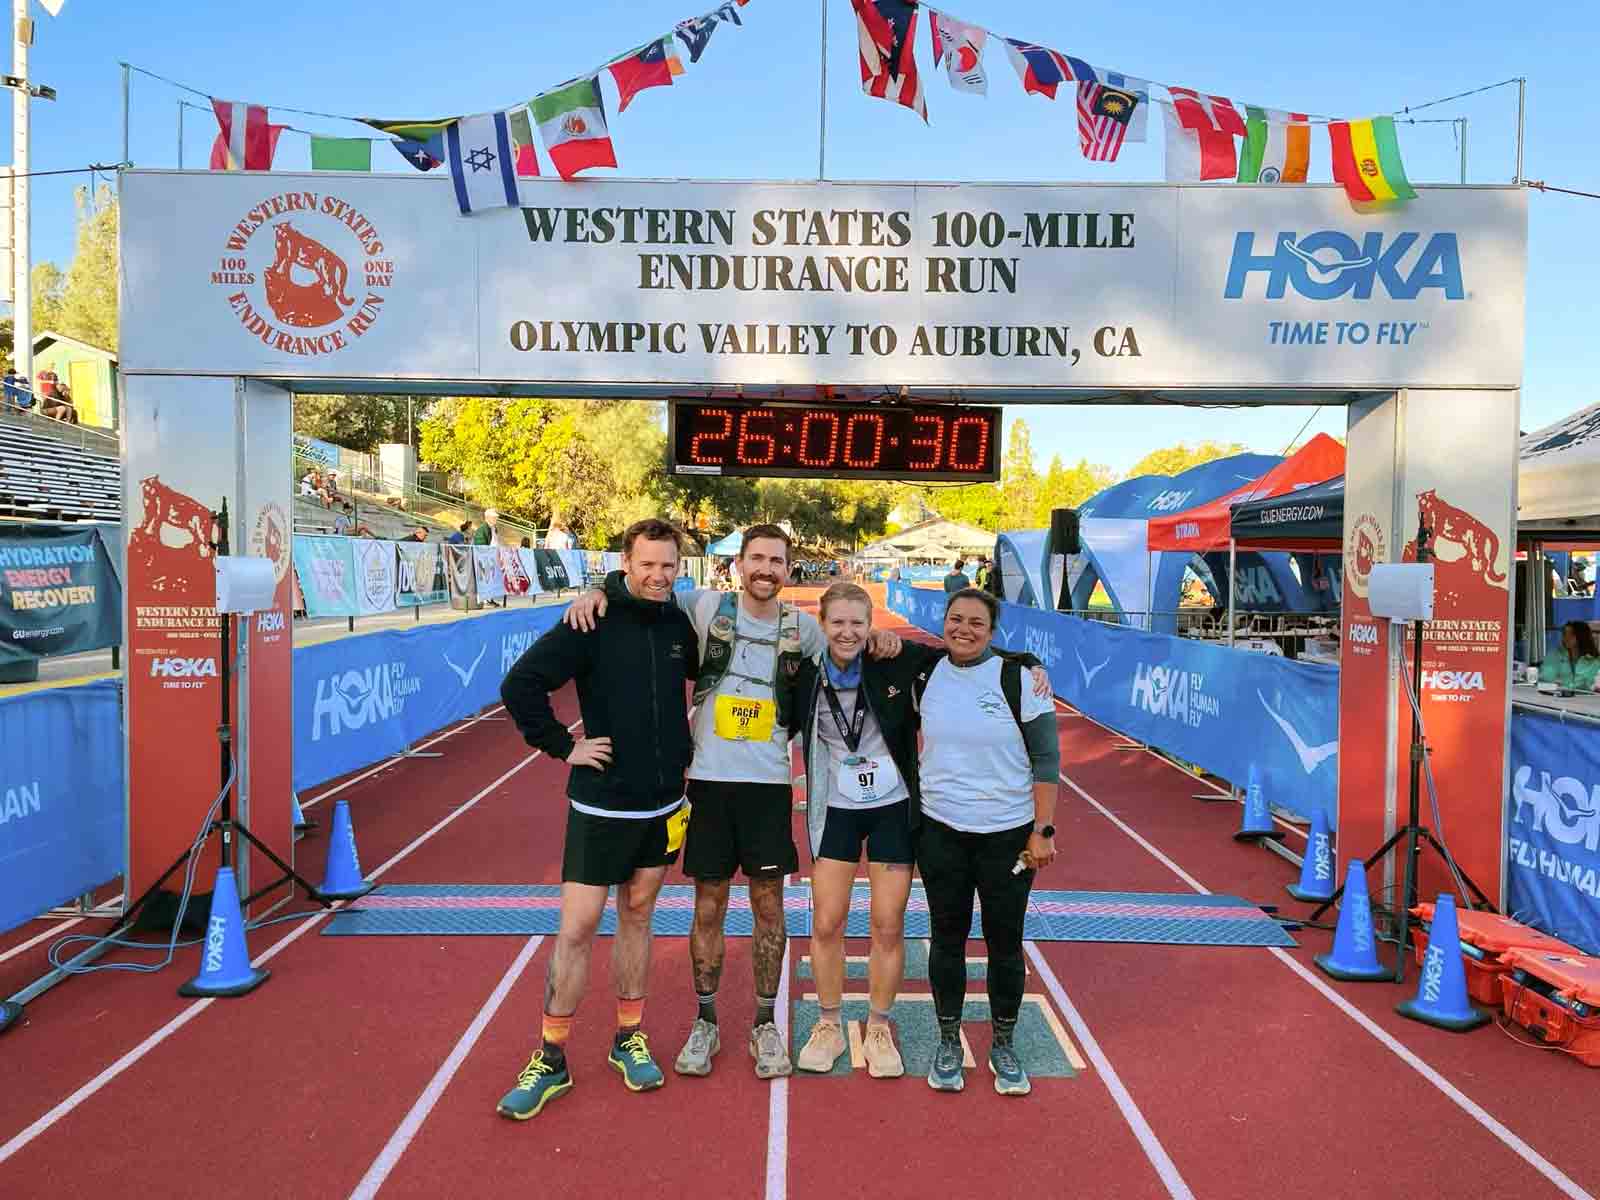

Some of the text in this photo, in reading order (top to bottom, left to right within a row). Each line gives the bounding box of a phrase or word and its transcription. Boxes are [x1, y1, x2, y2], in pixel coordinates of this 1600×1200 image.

[227, 192, 384, 255] WESTERN STATES
[520, 206, 1135, 248] WESTERN STATES 100-MILE
[220, 258, 246, 271] 100
[364, 261, 394, 273] ONE
[637, 254, 1020, 293] ENDURANCE RUN
[1224, 230, 1464, 300] HOKA
[211, 272, 255, 285] MILES
[365, 275, 393, 287] DAY
[228, 291, 384, 355] ENDURANCE RUN
[1269, 321, 1328, 345] TIME
[1335, 322, 1369, 345] TO
[510, 320, 1142, 366] OLYMPIC VALLEY TO AUBURN, CA
[1260, 504, 1324, 524] GUENERGY.COM
[0, 545, 95, 566] HYDRATION
[5, 567, 72, 587] ENERGY
[12, 586, 96, 610] RECOVERY
[136, 607, 189, 616] WESTERN
[136, 617, 231, 627] ENDURANCE RU
[257, 611, 286, 631] HOKA
[1349, 624, 1378, 644] HOKA
[1461, 620, 1500, 630] STATES
[1475, 630, 1500, 641] RUN
[151, 658, 216, 676] HOKA
[1191, 672, 1203, 690] FLY
[1421, 670, 1485, 691] HOKA
[312, 663, 394, 741] HOKA
[1131, 661, 1188, 726] HOKA
[1190, 690, 1220, 718] HUMAN
[732, 706, 759, 719] PACER
[740, 717, 750, 727] 97
[858, 772, 874, 788] 97
[0, 782, 41, 824] AN
[1314, 832, 1330, 881] HOKA
[1540, 849, 1600, 899] HUMA
[206, 915, 226, 972] HOKA
[1423, 944, 1444, 1001] HOKA
